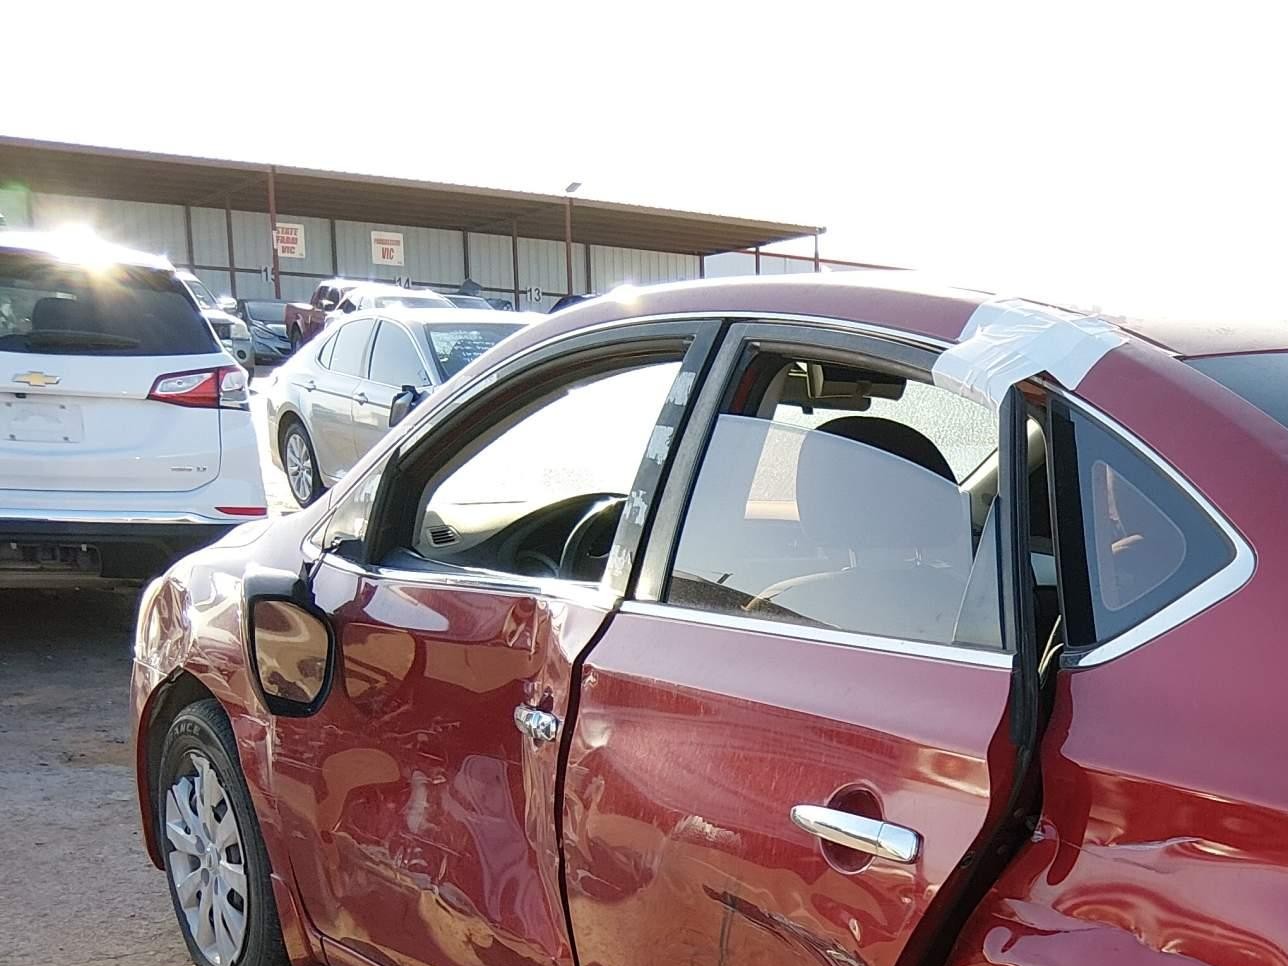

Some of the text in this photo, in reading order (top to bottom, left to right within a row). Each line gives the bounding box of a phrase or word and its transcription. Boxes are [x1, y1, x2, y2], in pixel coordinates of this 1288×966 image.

[281, 246, 296, 254] VIC
[381, 247, 395, 260] VIC
[528, 287, 542, 302] 13
